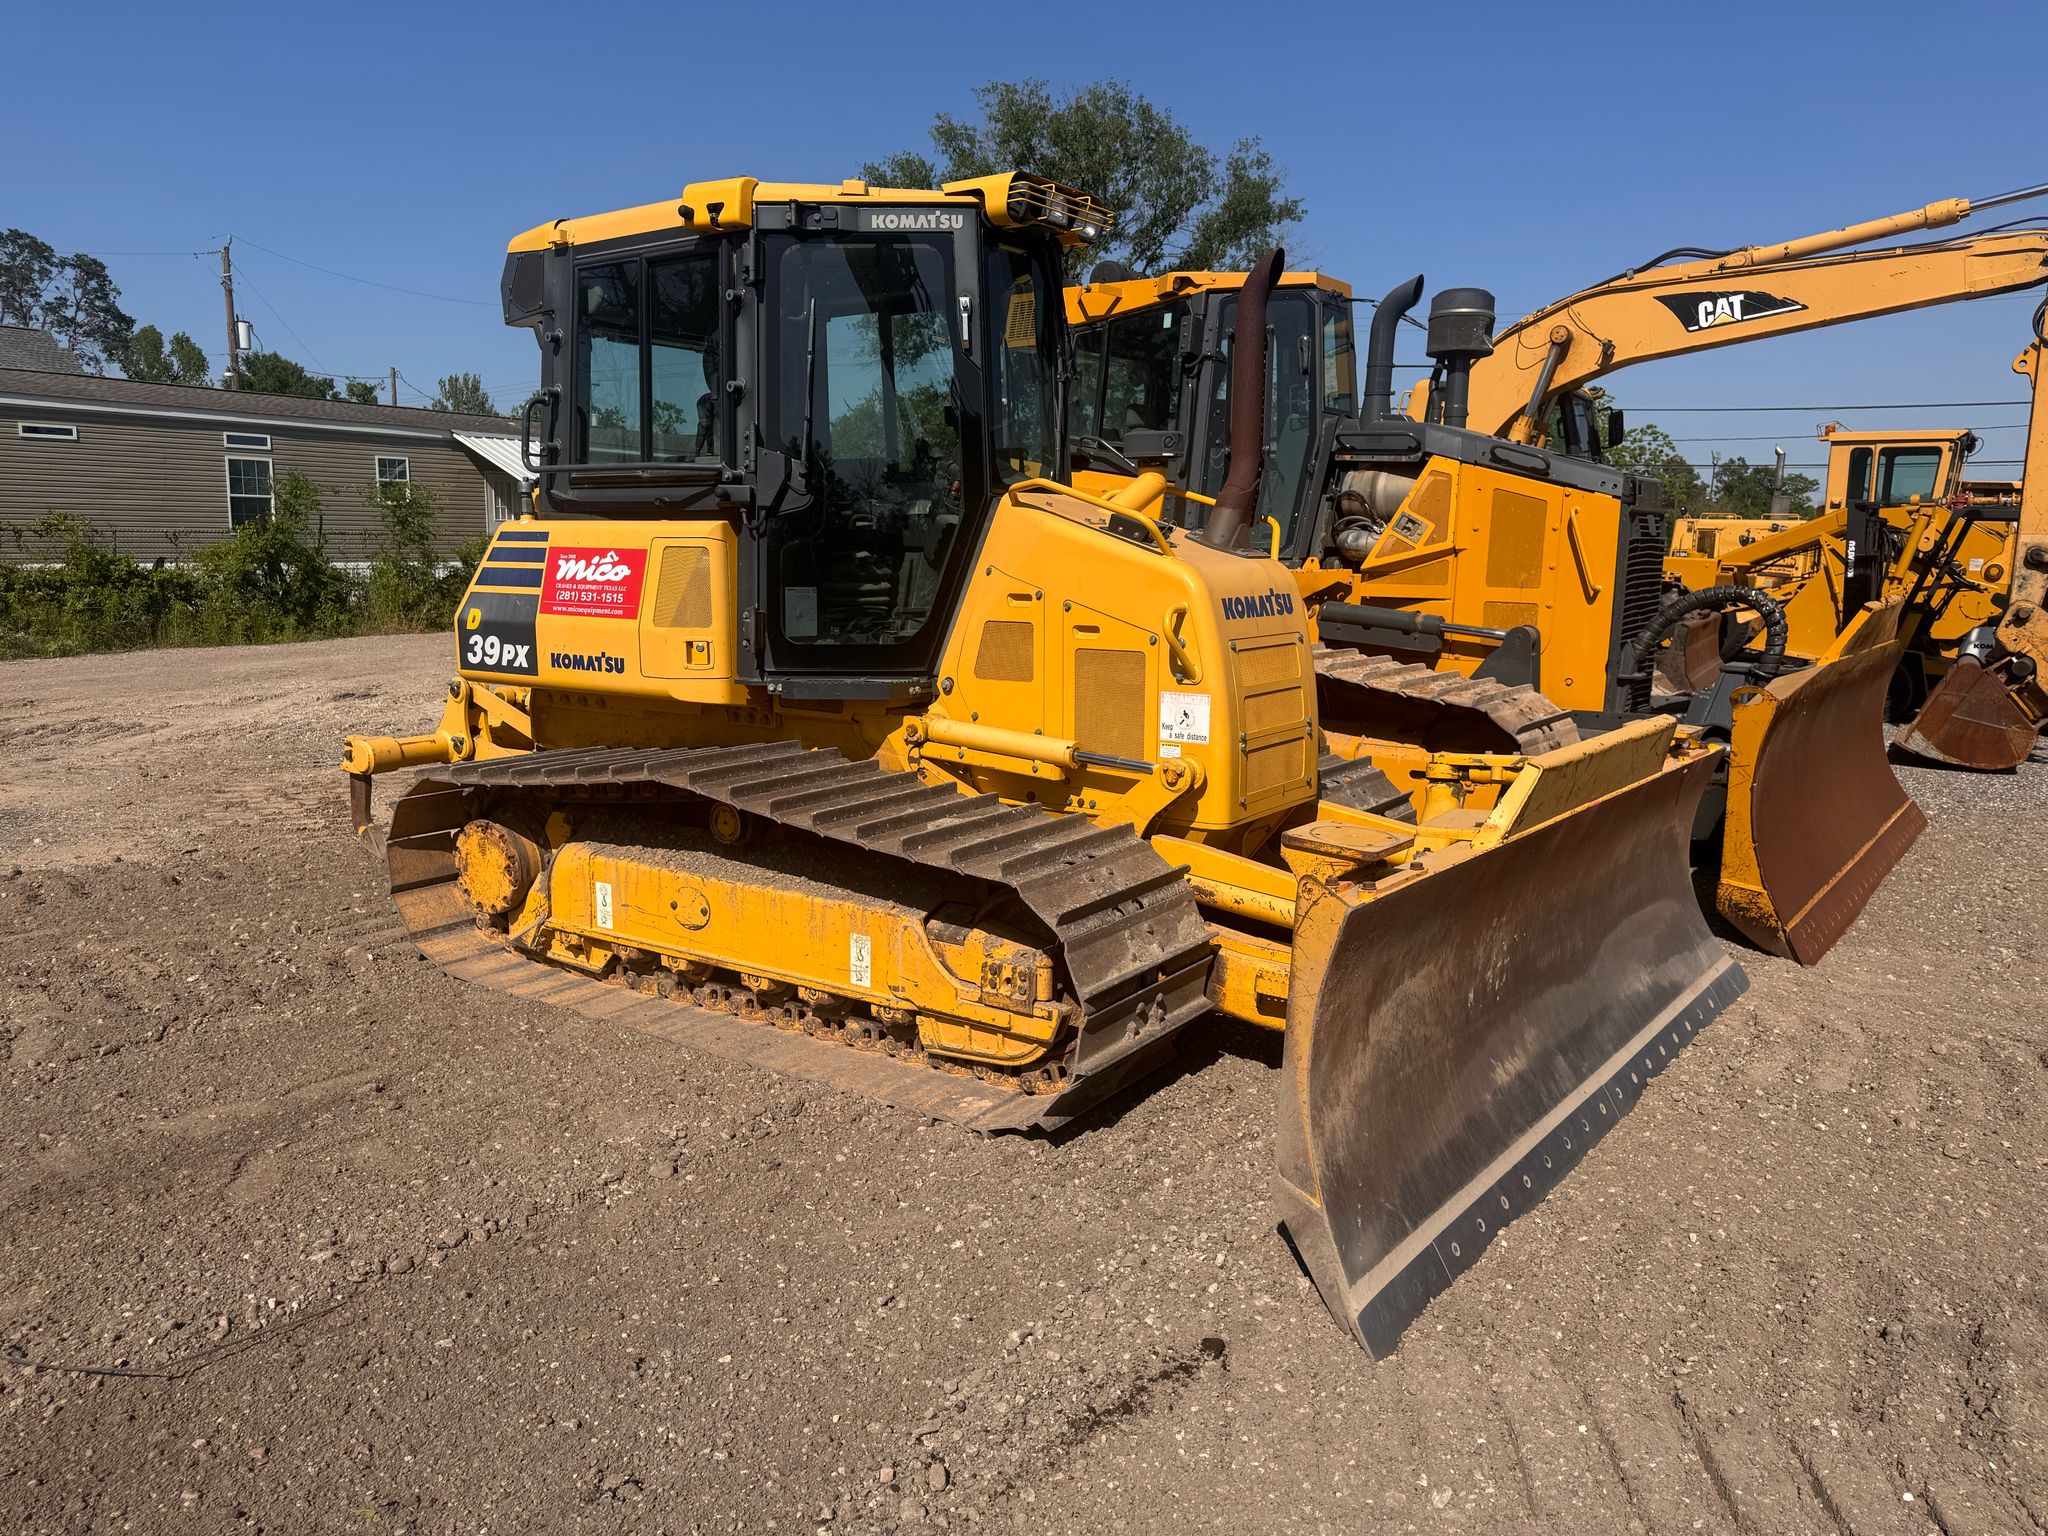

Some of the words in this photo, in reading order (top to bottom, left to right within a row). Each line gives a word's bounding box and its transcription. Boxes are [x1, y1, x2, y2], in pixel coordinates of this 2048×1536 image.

[871, 211, 963, 229] KOMATSU
[1698, 294, 1744, 327] CAT
[556, 590, 579, 602] (281)
[580, 591, 624, 603] 531-1515
[1221, 588, 1294, 620] KOMATSU
[466, 608, 482, 630] D
[552, 605, 624, 615] www.micoequipment.com
[550, 651, 625, 674] KOMATSU
[1161, 722, 1174, 732] Keep
[1174, 731, 1185, 740] safe
[1186, 732, 1208, 742] distance
